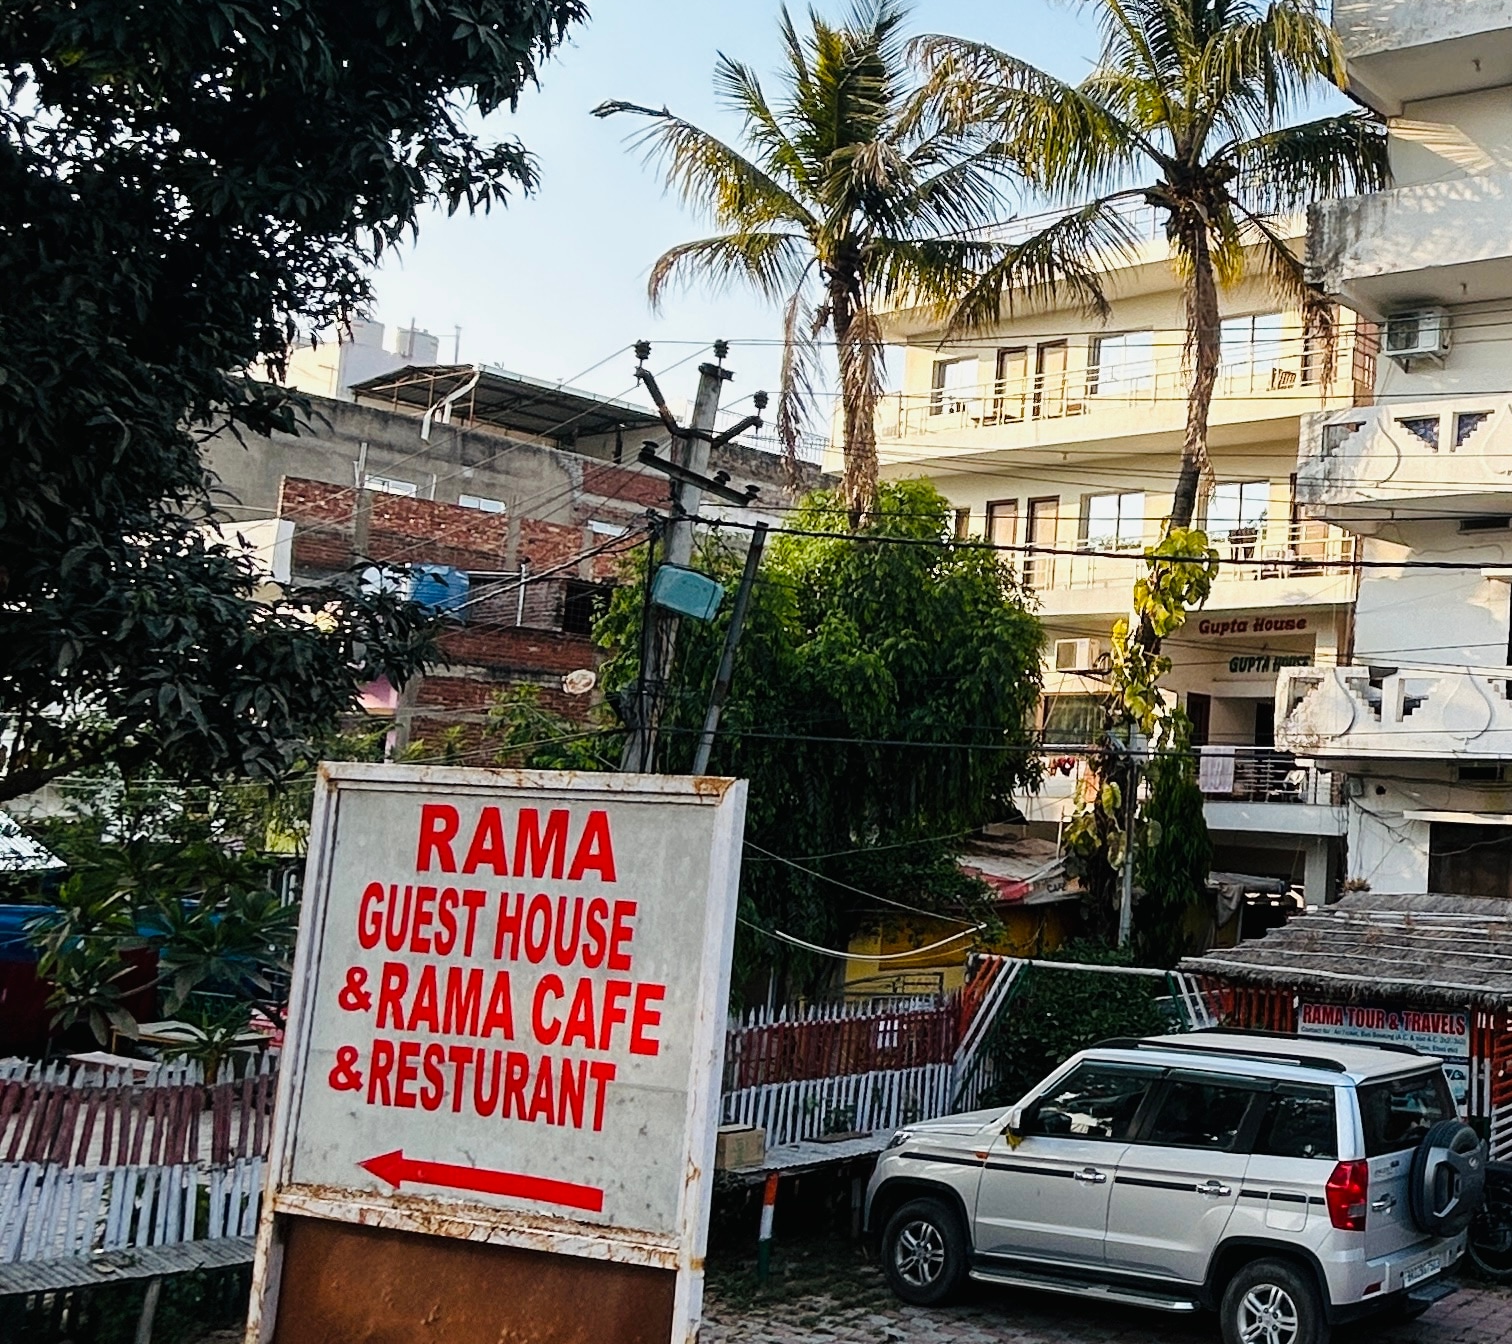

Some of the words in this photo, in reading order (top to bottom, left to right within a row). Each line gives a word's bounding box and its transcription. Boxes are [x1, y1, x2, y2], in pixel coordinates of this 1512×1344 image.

[1198, 619, 1248, 636] Gupta
[1252, 617, 1308, 633] House
[1228, 656, 1270, 673] GUPTA
[415, 803, 617, 883] RAMA
[357, 882, 487, 957] GUEST
[493, 892, 638, 971] HOUSE
[531, 973, 667, 1056] CAFE
[1302, 1003, 1344, 1027] RAMA
[1345, 1006, 1386, 1030] TOUR
[1388, 1012, 1400, 1031] &
[1402, 1010, 1467, 1036] TRAVELS
